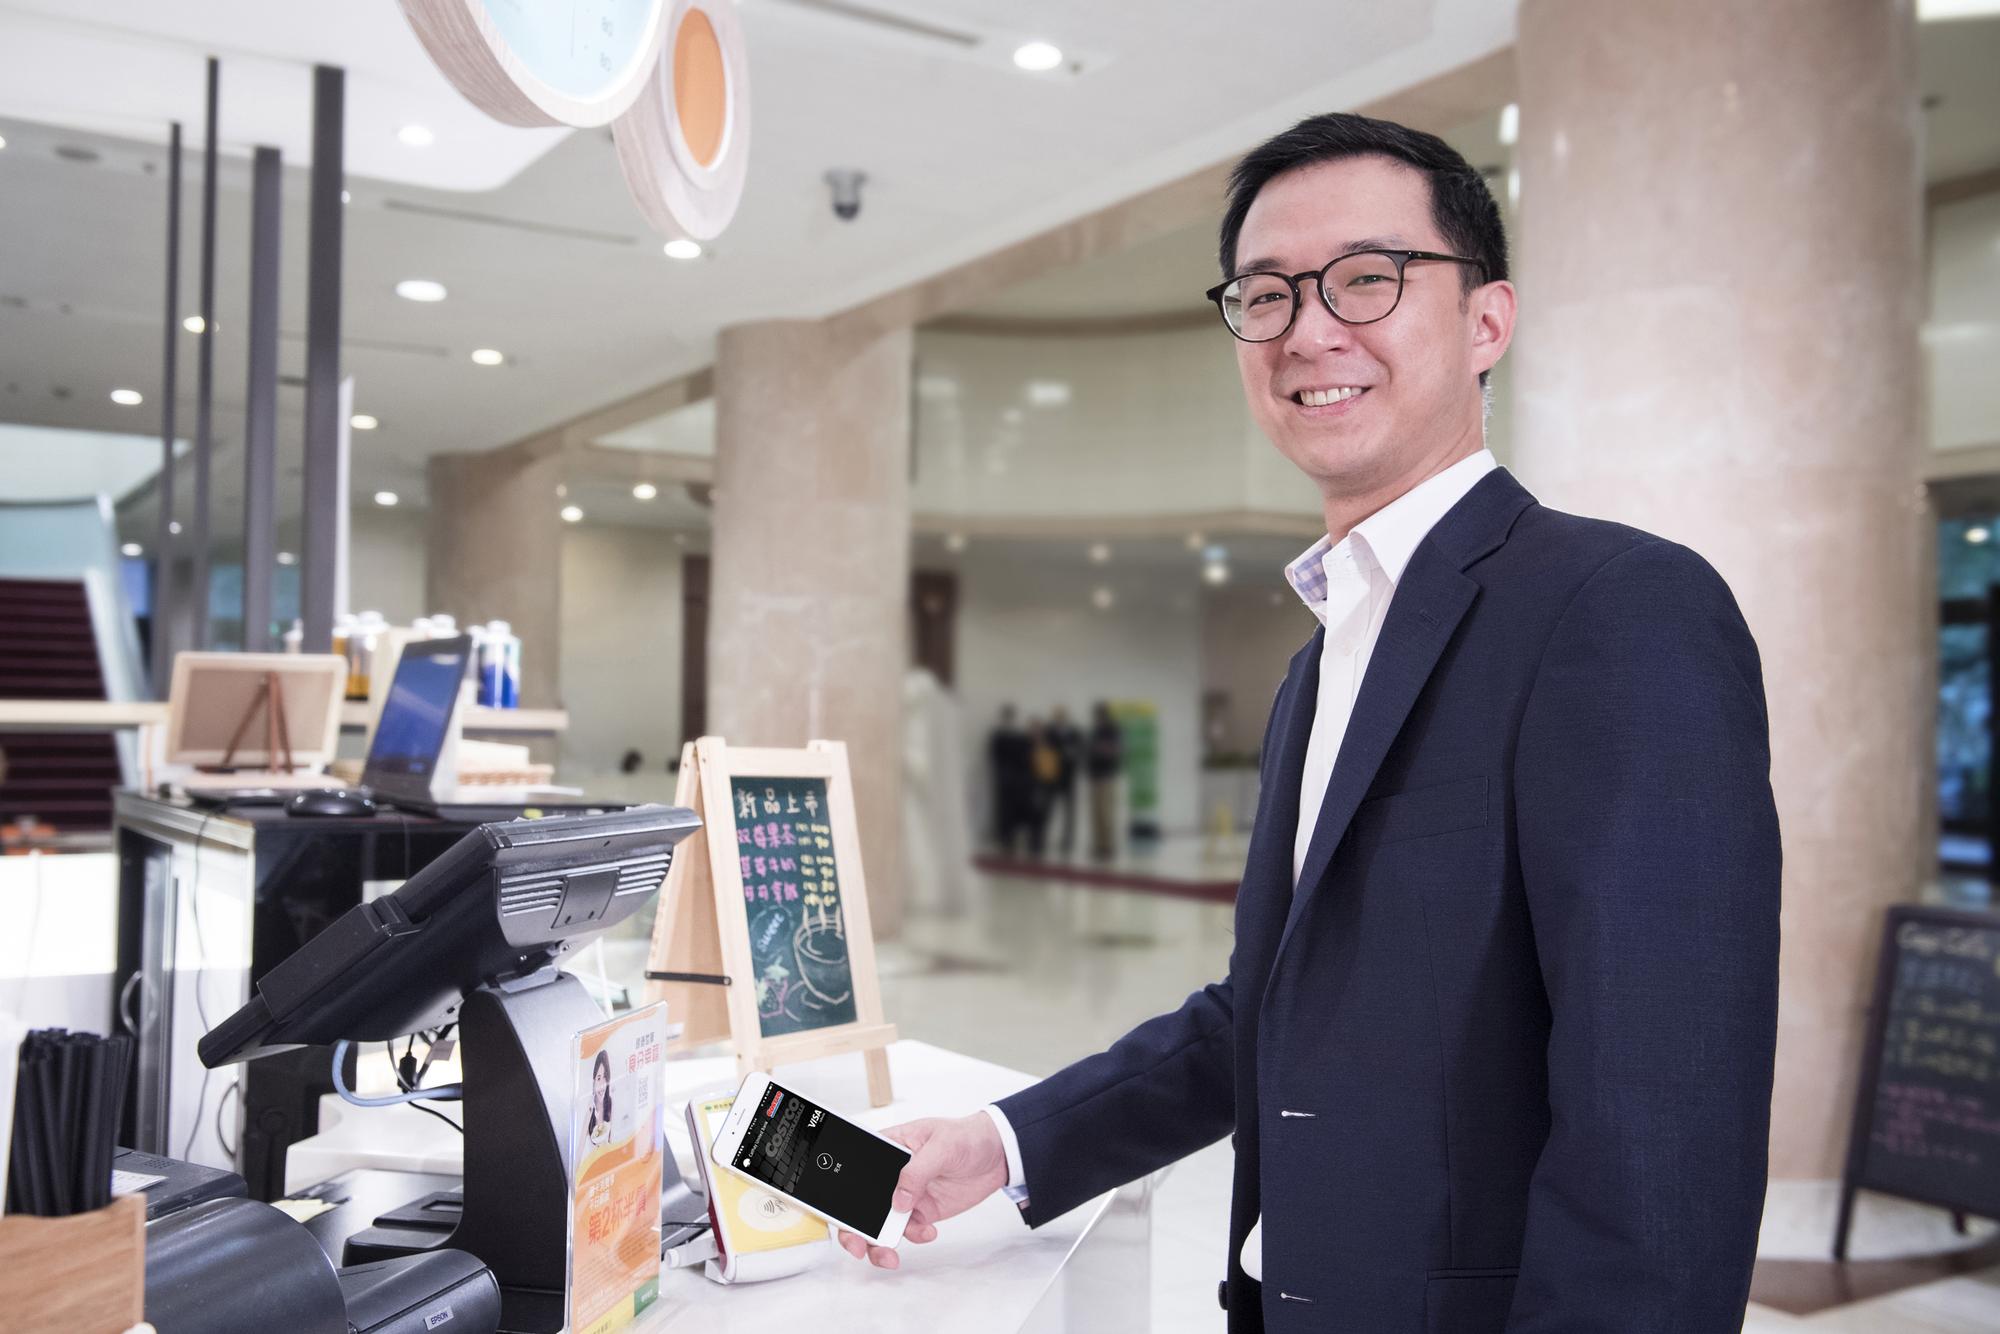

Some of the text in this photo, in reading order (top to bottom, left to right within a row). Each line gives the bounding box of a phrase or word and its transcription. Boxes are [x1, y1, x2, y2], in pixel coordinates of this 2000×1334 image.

[738, 787, 818, 818] 新品上市
[765, 1098, 800, 1157] COSTCO
[808, 1109, 822, 1128] VISA
[430, 1311, 449, 1325] EPSON
